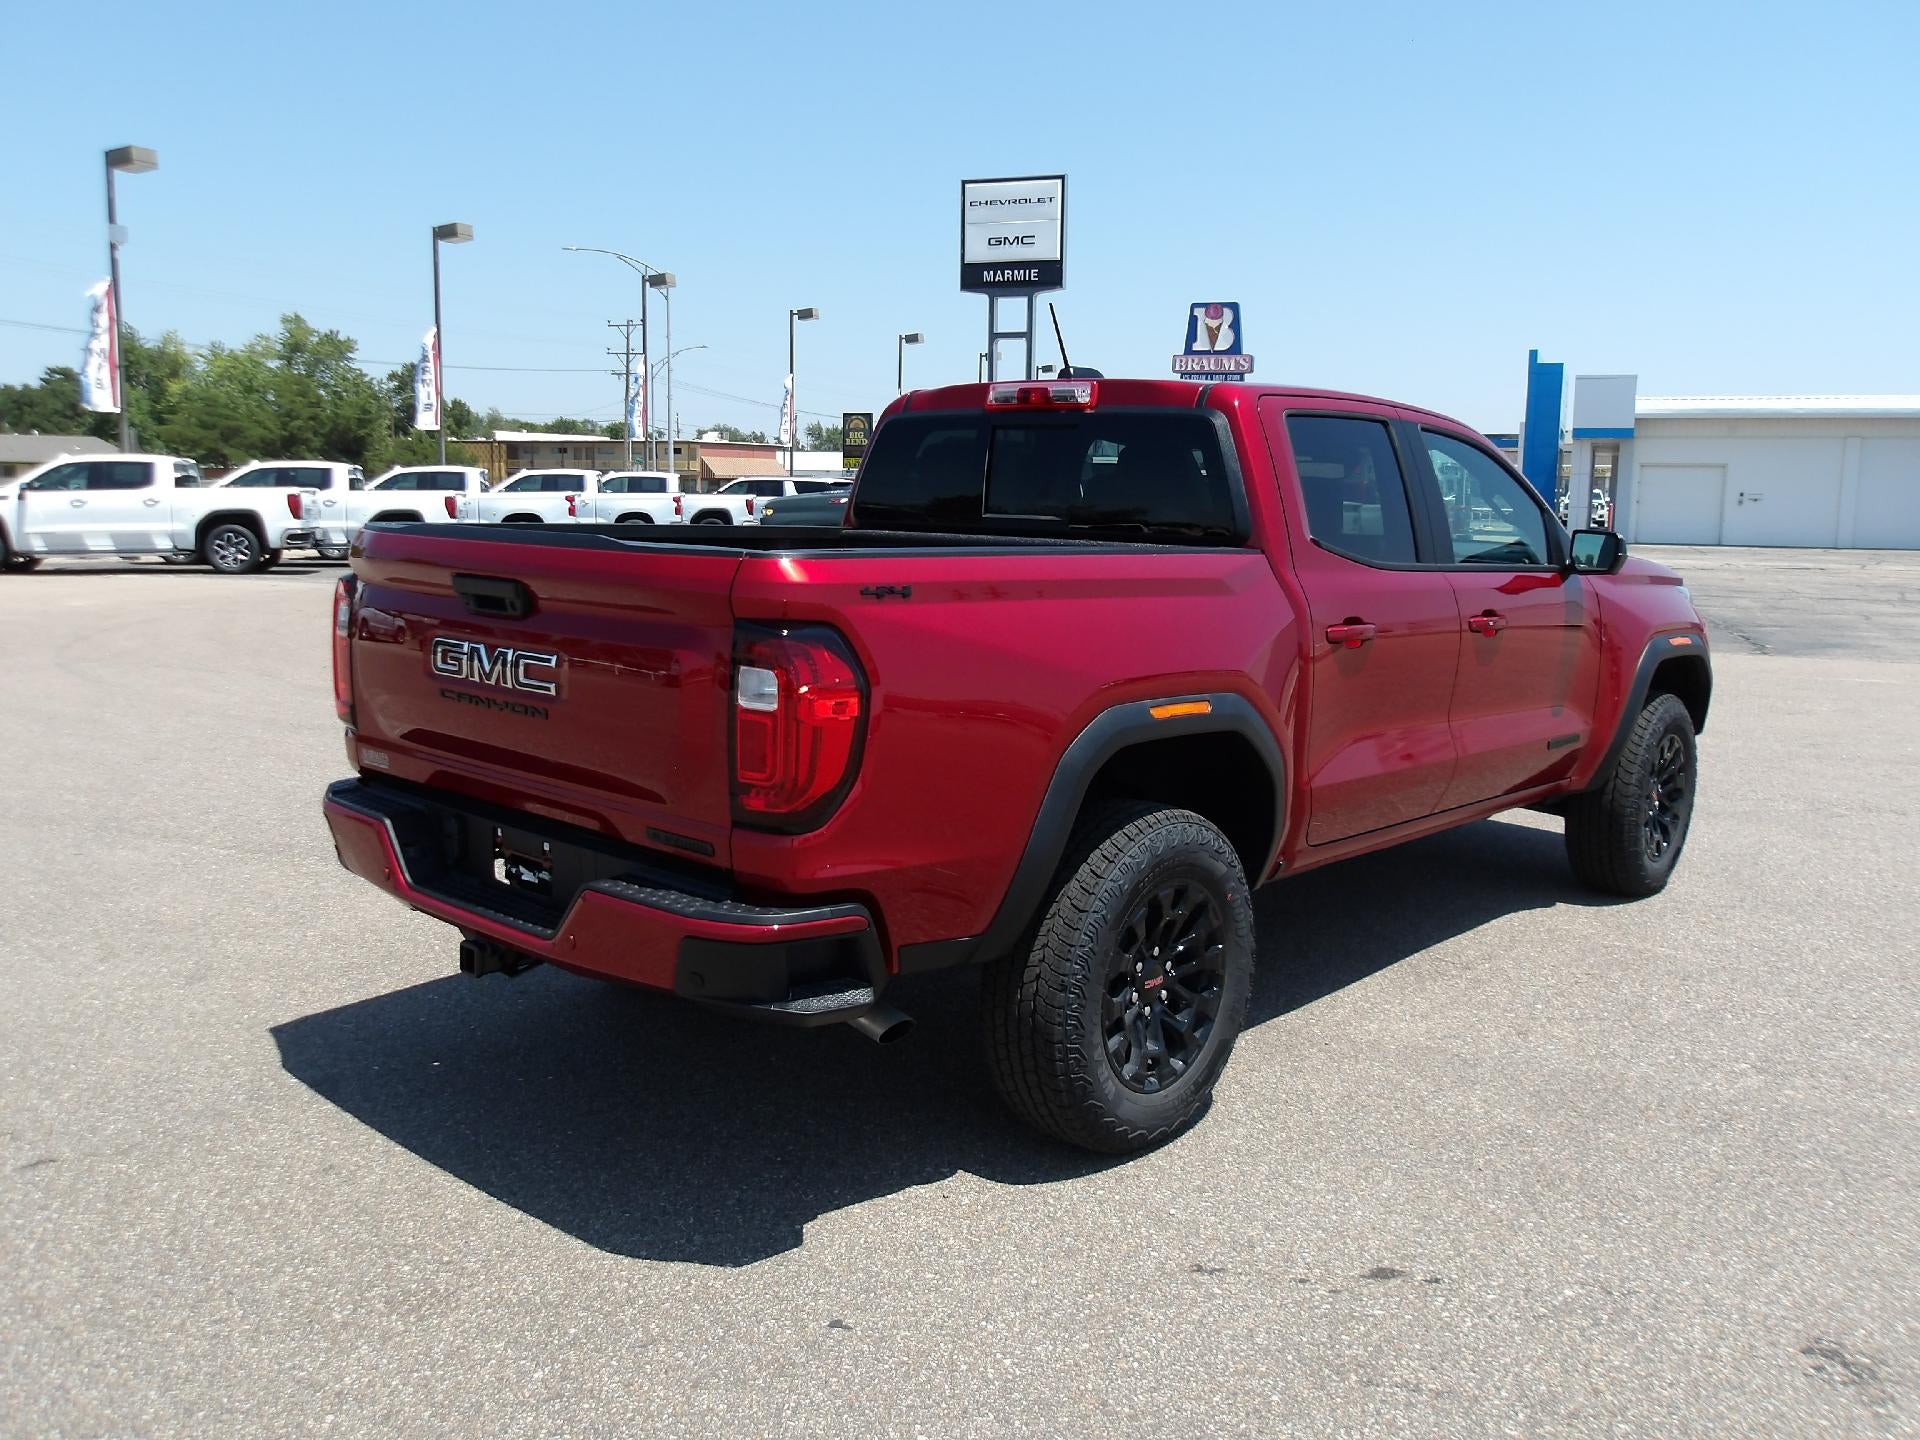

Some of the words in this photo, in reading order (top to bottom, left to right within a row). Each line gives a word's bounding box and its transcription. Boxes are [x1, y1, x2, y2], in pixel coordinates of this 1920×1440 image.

[969, 197, 1055, 207] CHEVROLET
[988, 235, 1036, 246] GMC
[983, 269, 1039, 282] MARMIE
[1174, 357, 1249, 371] BRAUM'S
[431, 637, 558, 697] GMC
[439, 687, 549, 721] CANYON
